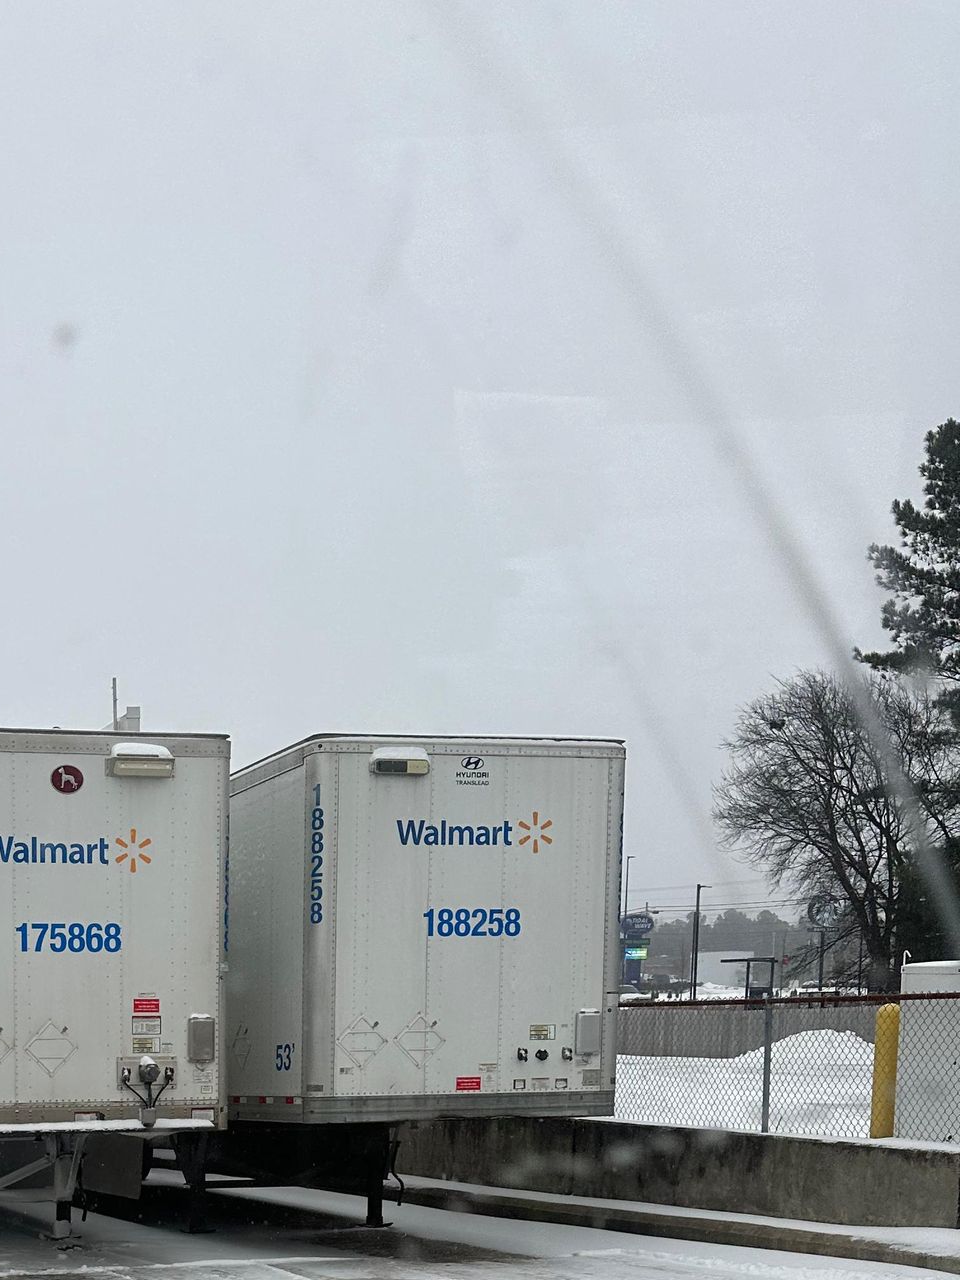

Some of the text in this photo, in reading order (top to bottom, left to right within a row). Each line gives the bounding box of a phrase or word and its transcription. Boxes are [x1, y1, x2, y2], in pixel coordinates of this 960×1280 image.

[396, 819, 513, 846] Walmart
[310, 784, 324, 924] 188258
[423, 908, 521, 937] 188258
[16, 922, 122, 953] 175868
[275, 1043, 295, 1072] 53'
